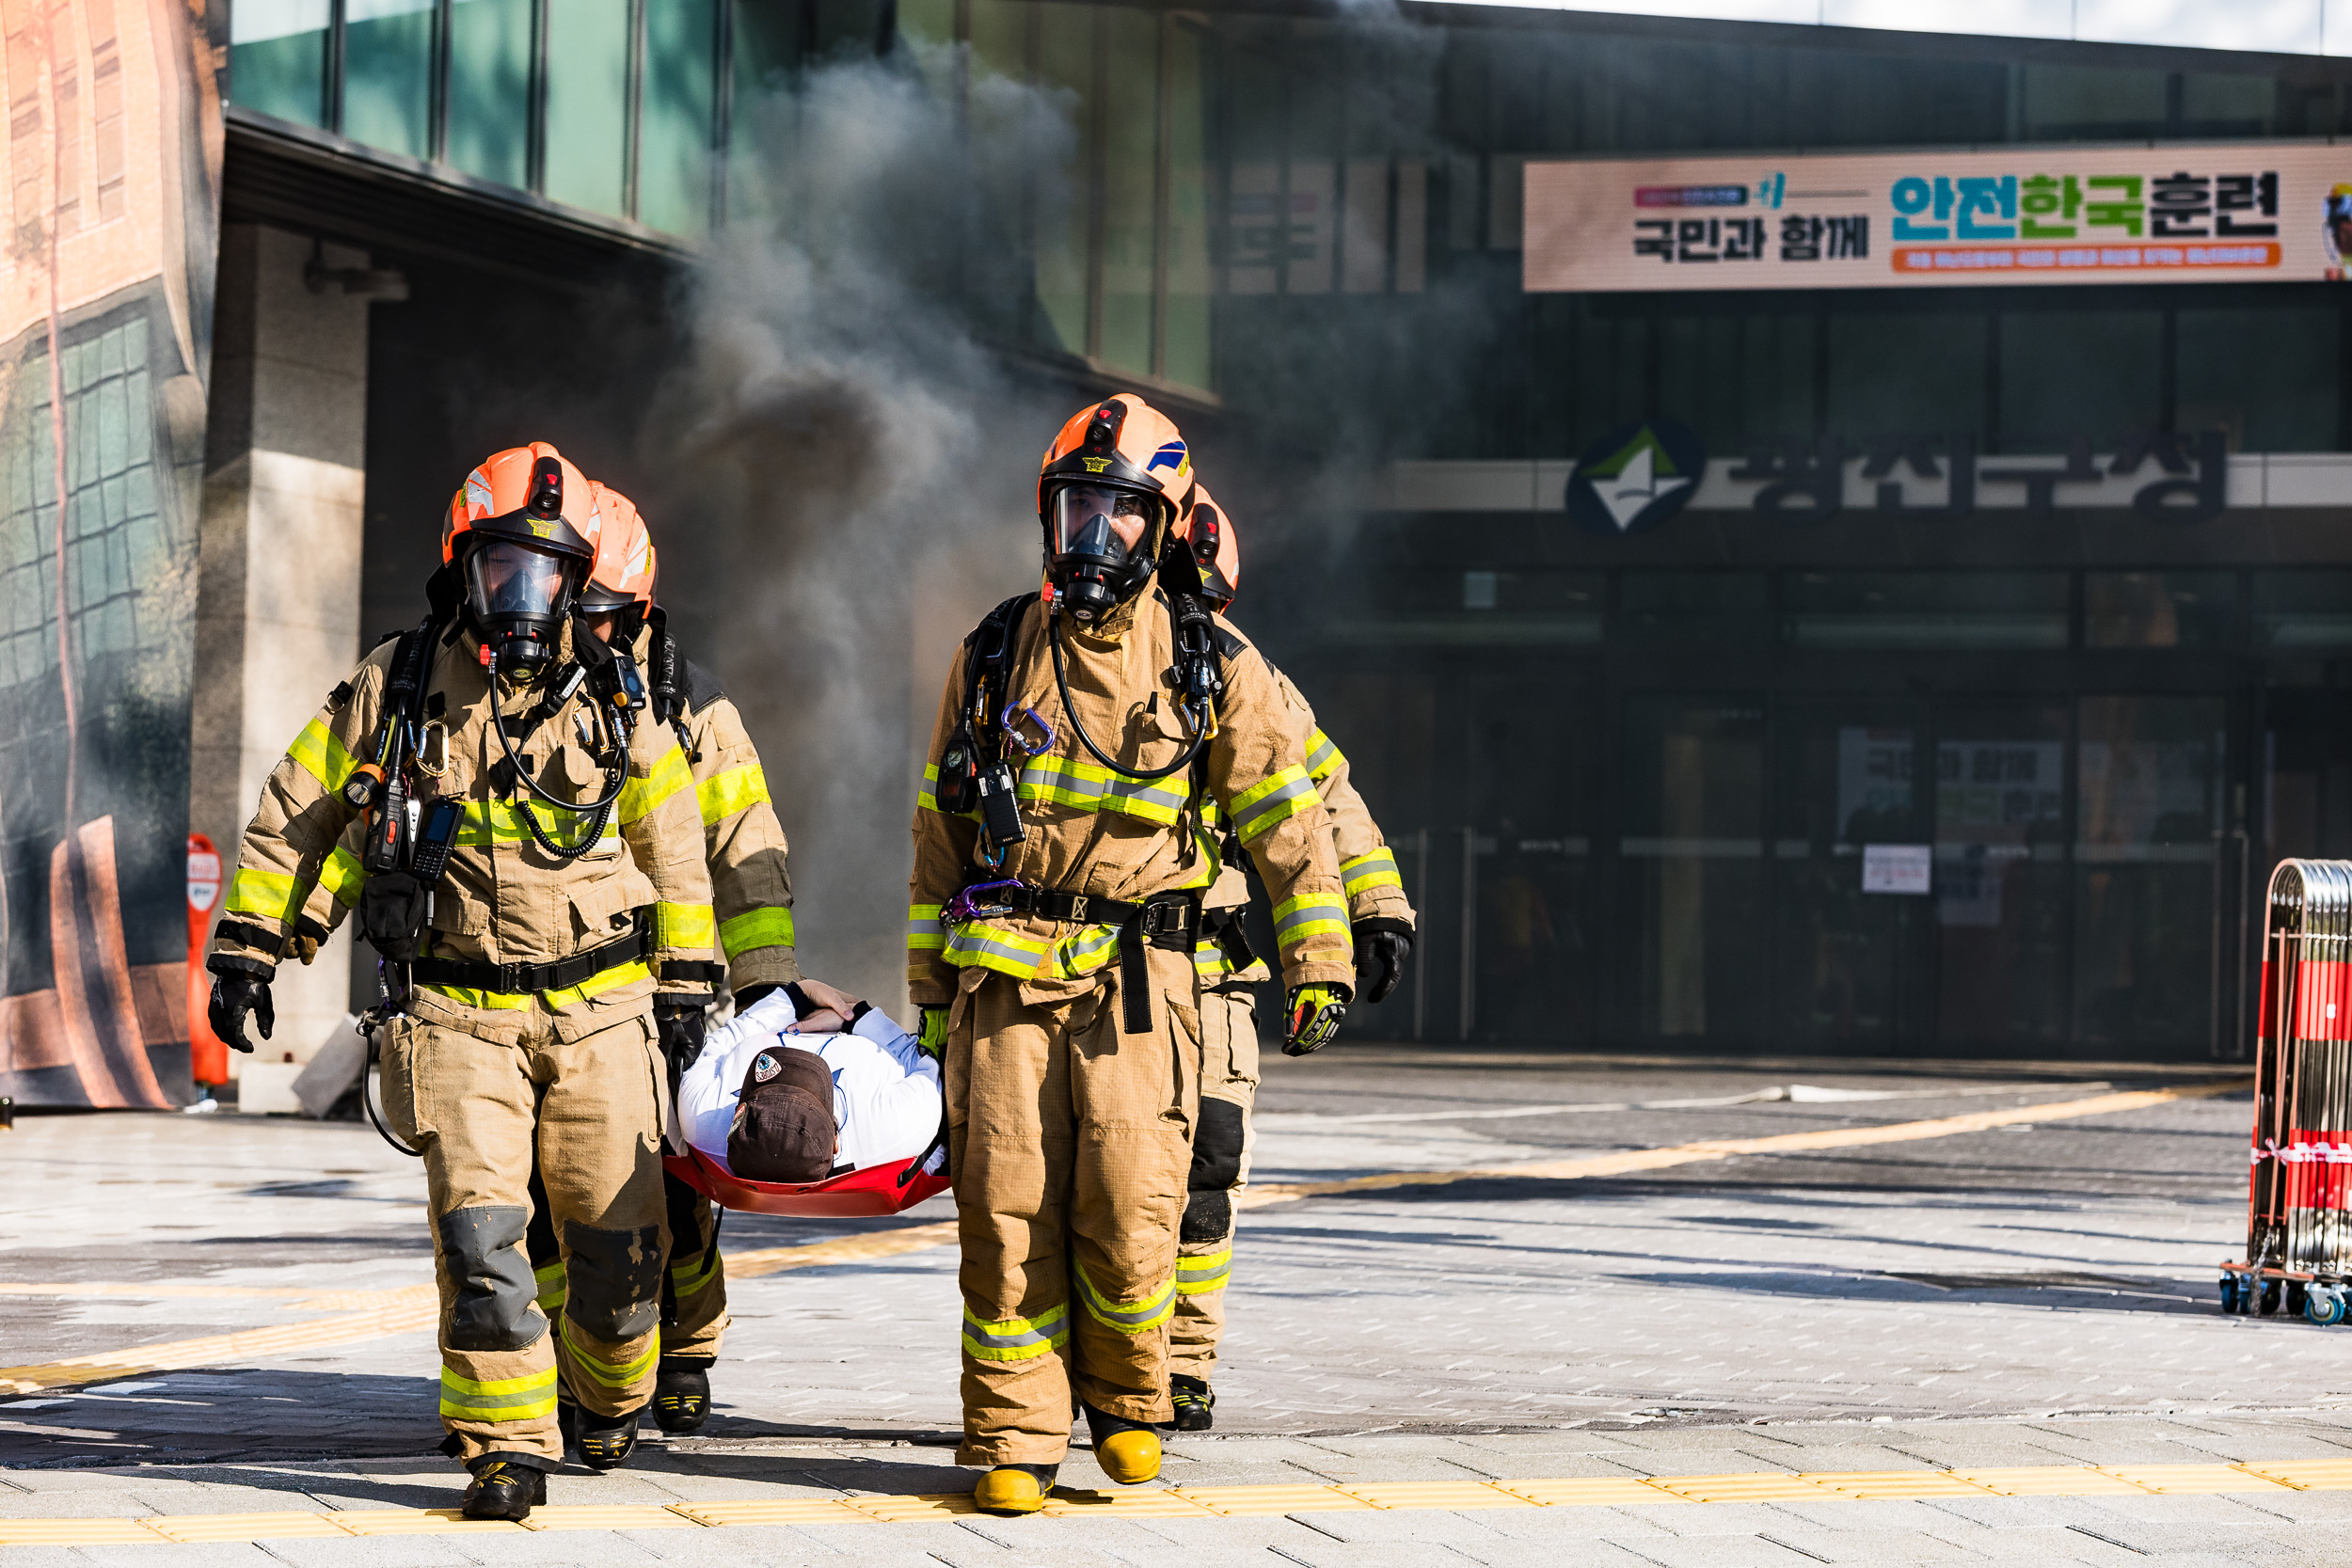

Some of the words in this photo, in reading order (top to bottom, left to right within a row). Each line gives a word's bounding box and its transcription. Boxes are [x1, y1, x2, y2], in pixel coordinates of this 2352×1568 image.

[1891, 171, 2279, 240] 안전한국훈련
[1634, 216, 1766, 262] 국민과
[1780, 213, 1870, 261] 함께
